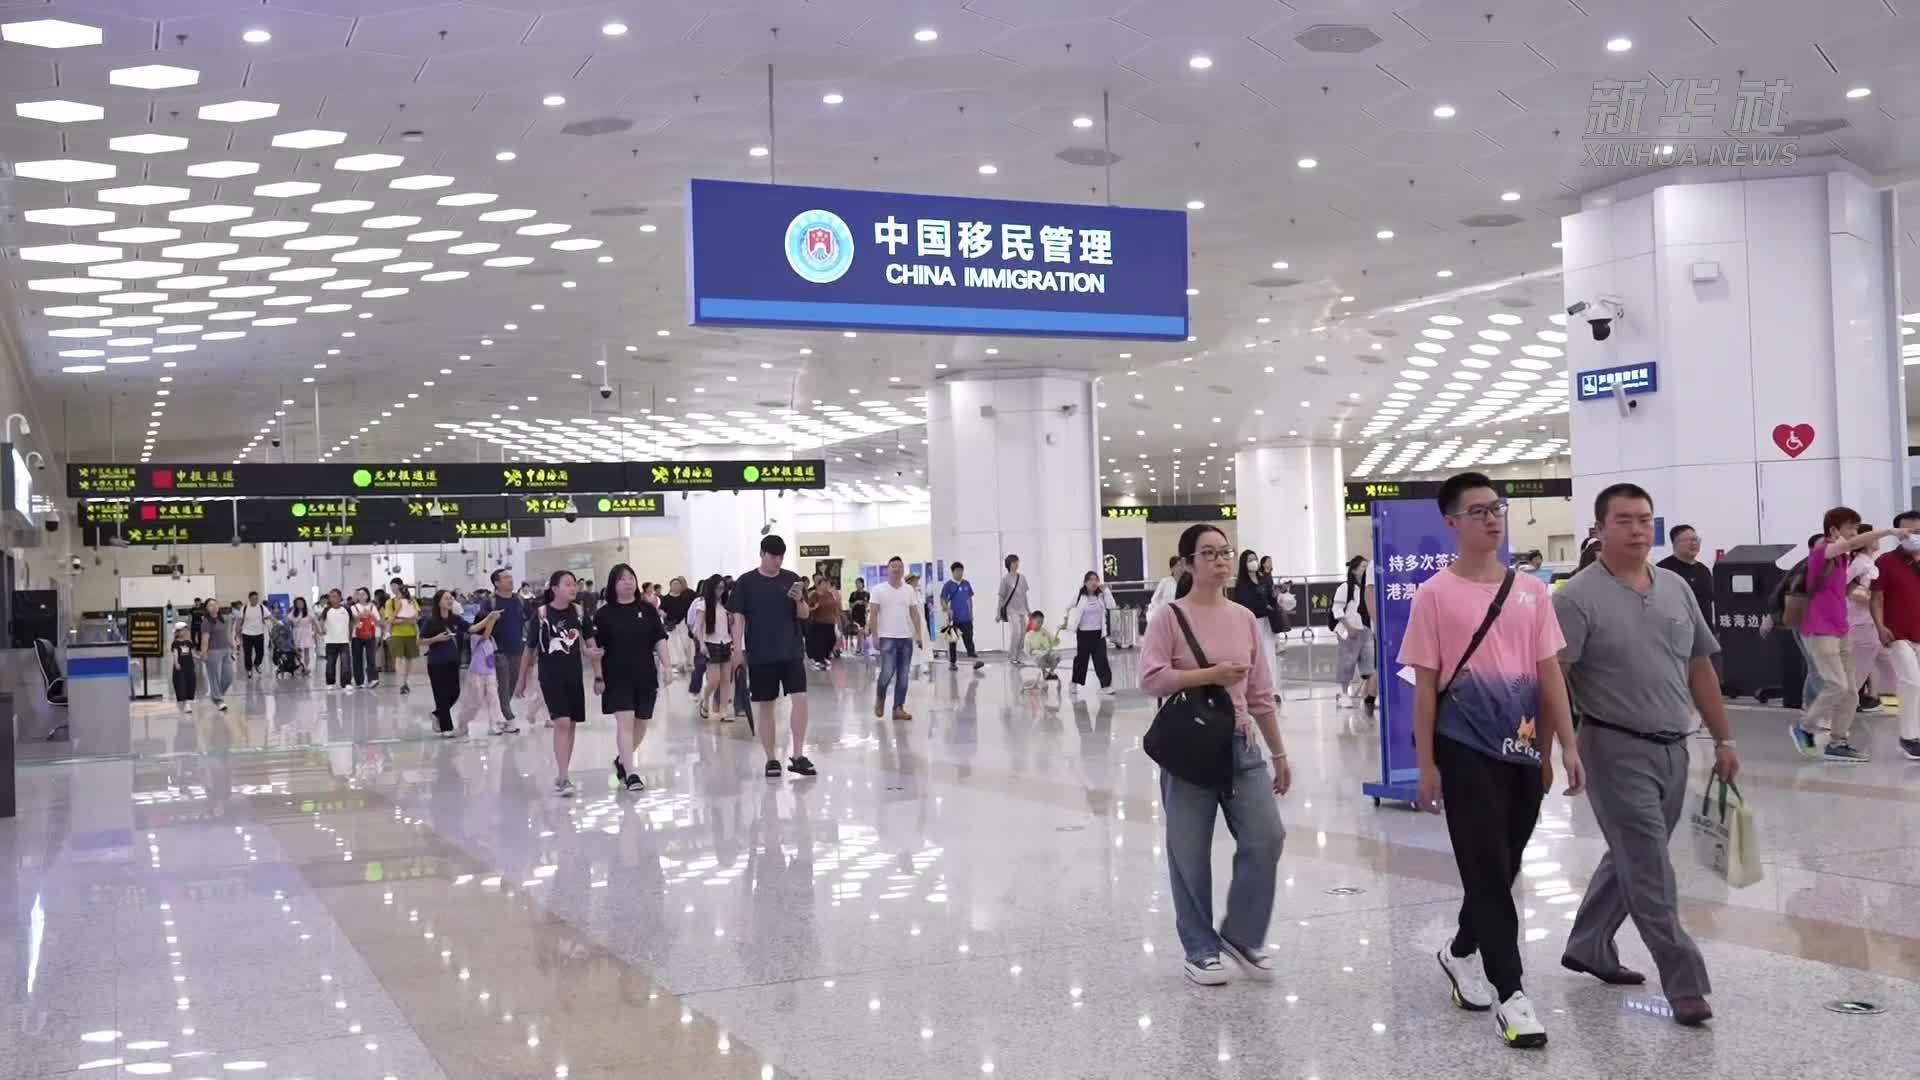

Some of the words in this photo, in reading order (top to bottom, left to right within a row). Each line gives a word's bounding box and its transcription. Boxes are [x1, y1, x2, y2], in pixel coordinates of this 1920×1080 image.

[874, 215, 1113, 265] 中国移民管理
[885, 263, 957, 287] CHINA
[964, 267, 1105, 293] IMMIGRATION
